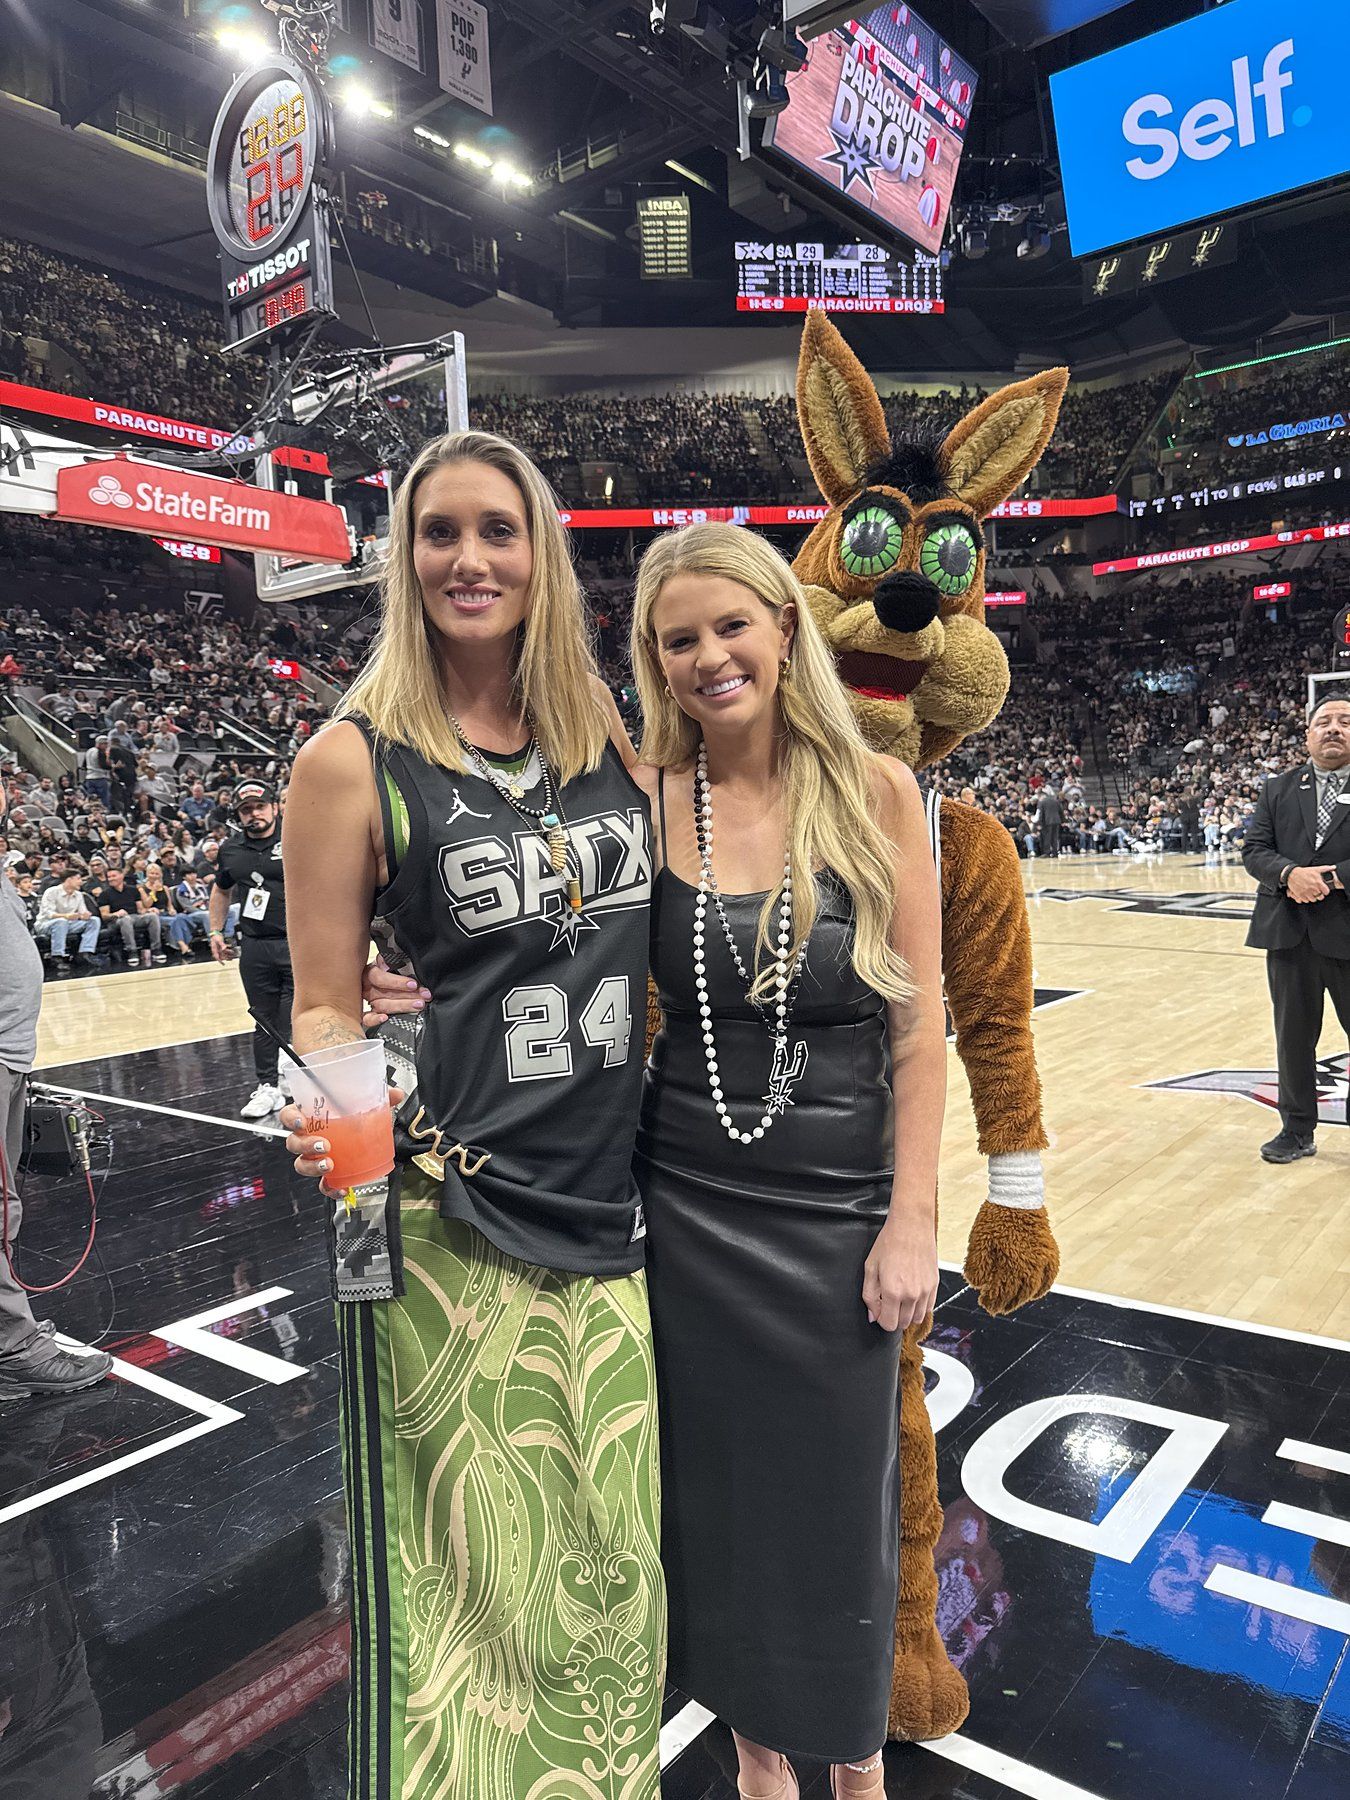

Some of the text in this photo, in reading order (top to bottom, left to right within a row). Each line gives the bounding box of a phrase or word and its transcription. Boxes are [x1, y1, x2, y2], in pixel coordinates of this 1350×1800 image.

[451, 11, 475, 41] POP
[450, 34, 478, 64] 1,390
[841, 51, 931, 147] PARACHUTE
[832, 80, 926, 182] DROP
[246, 142, 304, 241] 24
[248, 238, 311, 288] TISSOT
[776, 245, 879, 260] SA 29 28
[808, 299, 933, 312] PARACHUTE DROP
[95, 407, 207, 445] PARACHUTE
[1269, 413, 1346, 442] GLORIA
[1210, 488, 1228, 501] TO
[1307, 470, 1326, 484] PF
[1137, 541, 1250, 568] PARACHUTE DROP
[438, 808, 651, 938] SATX
[502, 976, 632, 1083] 24
